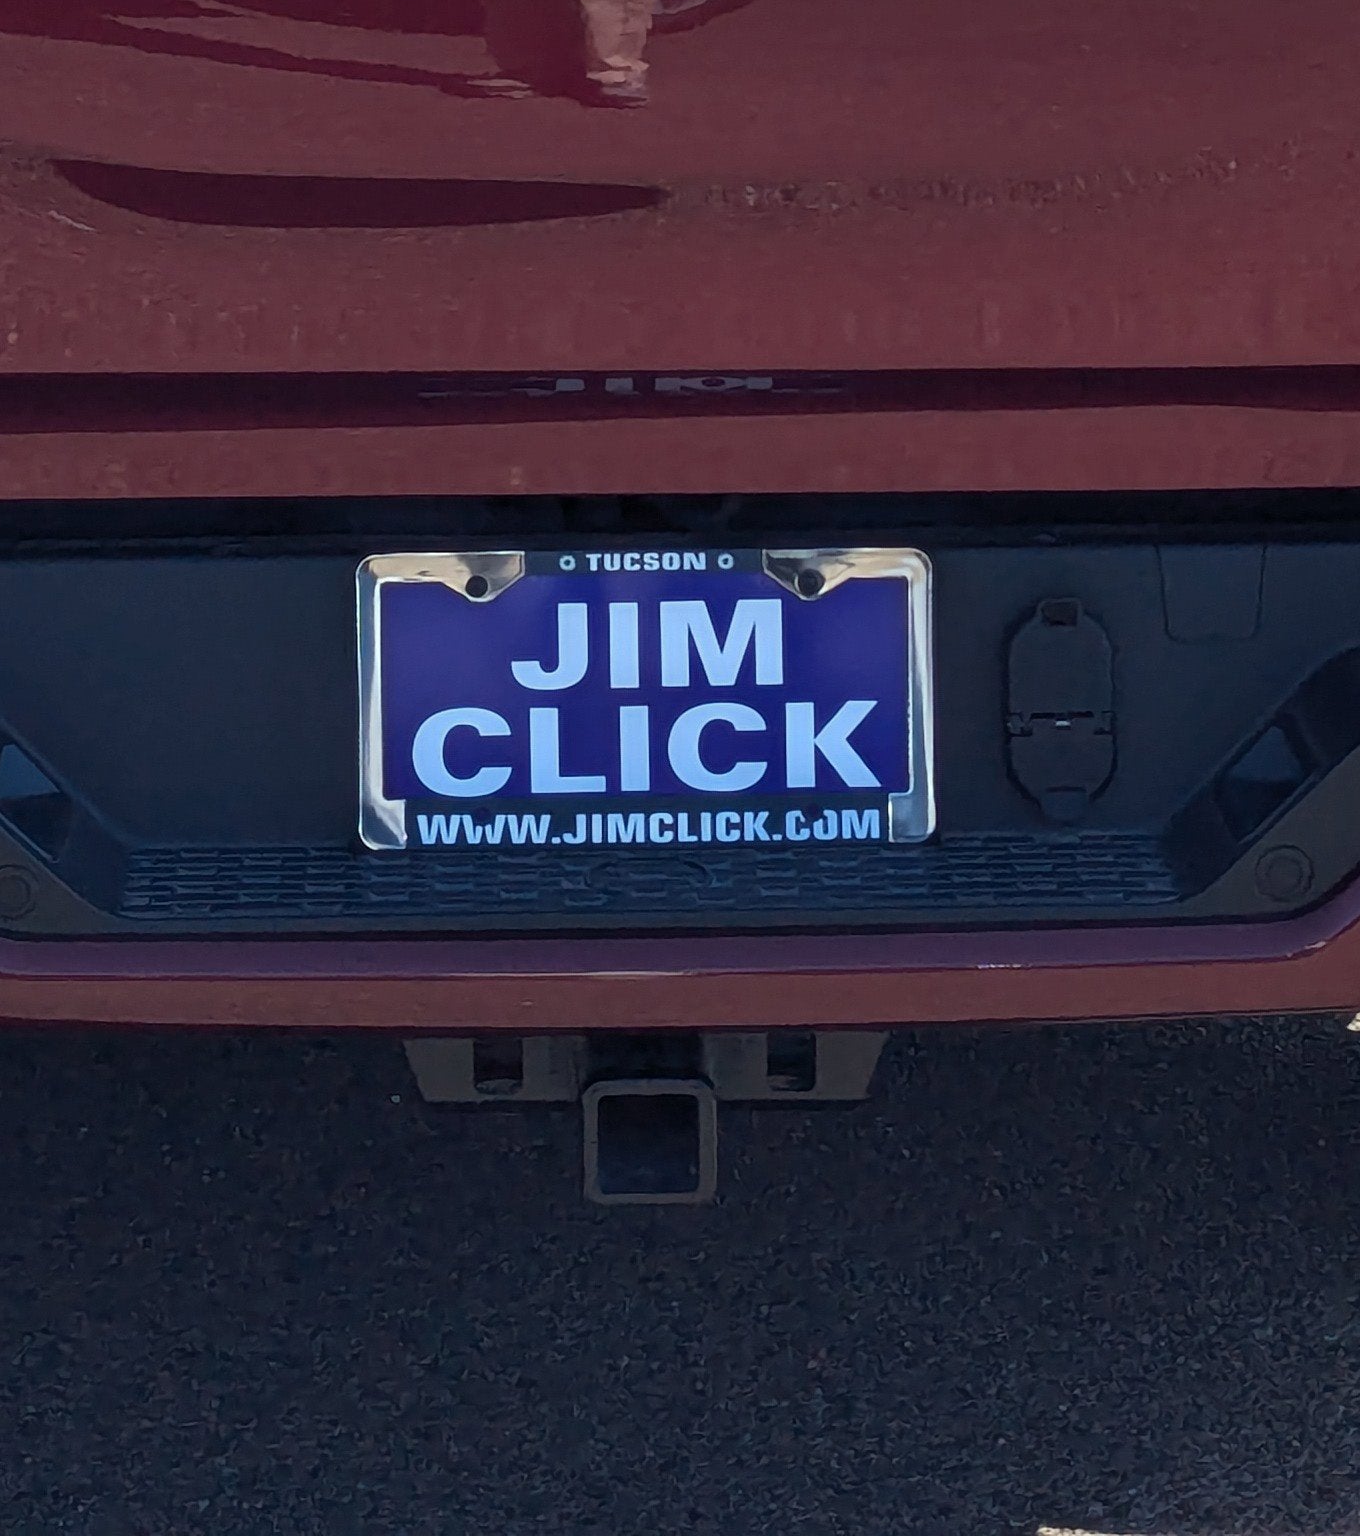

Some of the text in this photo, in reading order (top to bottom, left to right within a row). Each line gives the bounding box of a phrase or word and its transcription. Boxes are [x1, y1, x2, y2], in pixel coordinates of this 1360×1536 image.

[585, 552, 707, 572] TUCSON
[510, 598, 784, 690] JIM
[411, 700, 882, 798] CLICK
[416, 808, 881, 846] WWW.JIMCLICK.COM
